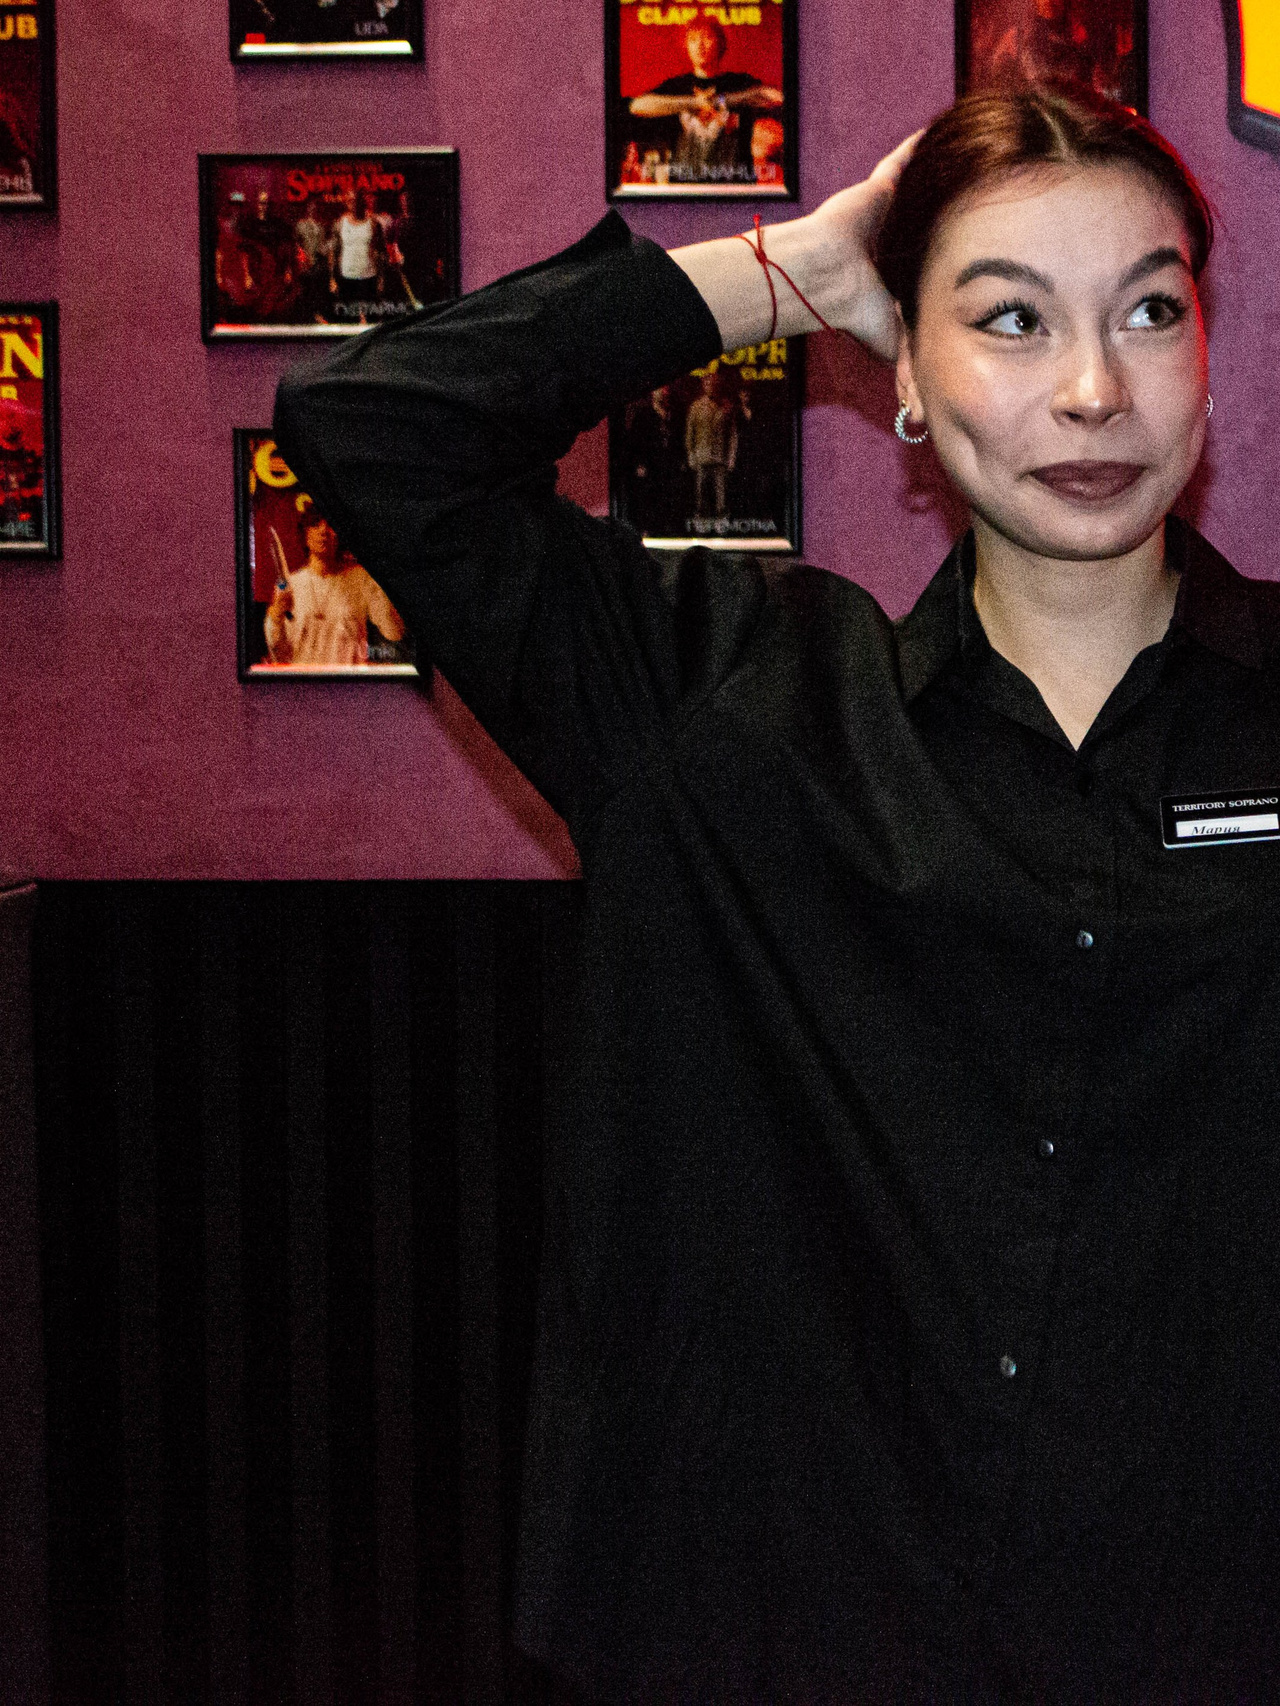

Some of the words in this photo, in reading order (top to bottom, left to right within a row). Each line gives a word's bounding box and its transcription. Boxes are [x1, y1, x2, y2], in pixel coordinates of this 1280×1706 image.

[637, 5, 762, 26] CLANCLUB
[1172, 801, 1227, 812] TERRITORY
[1229, 797, 1279, 808] SOPRANO
